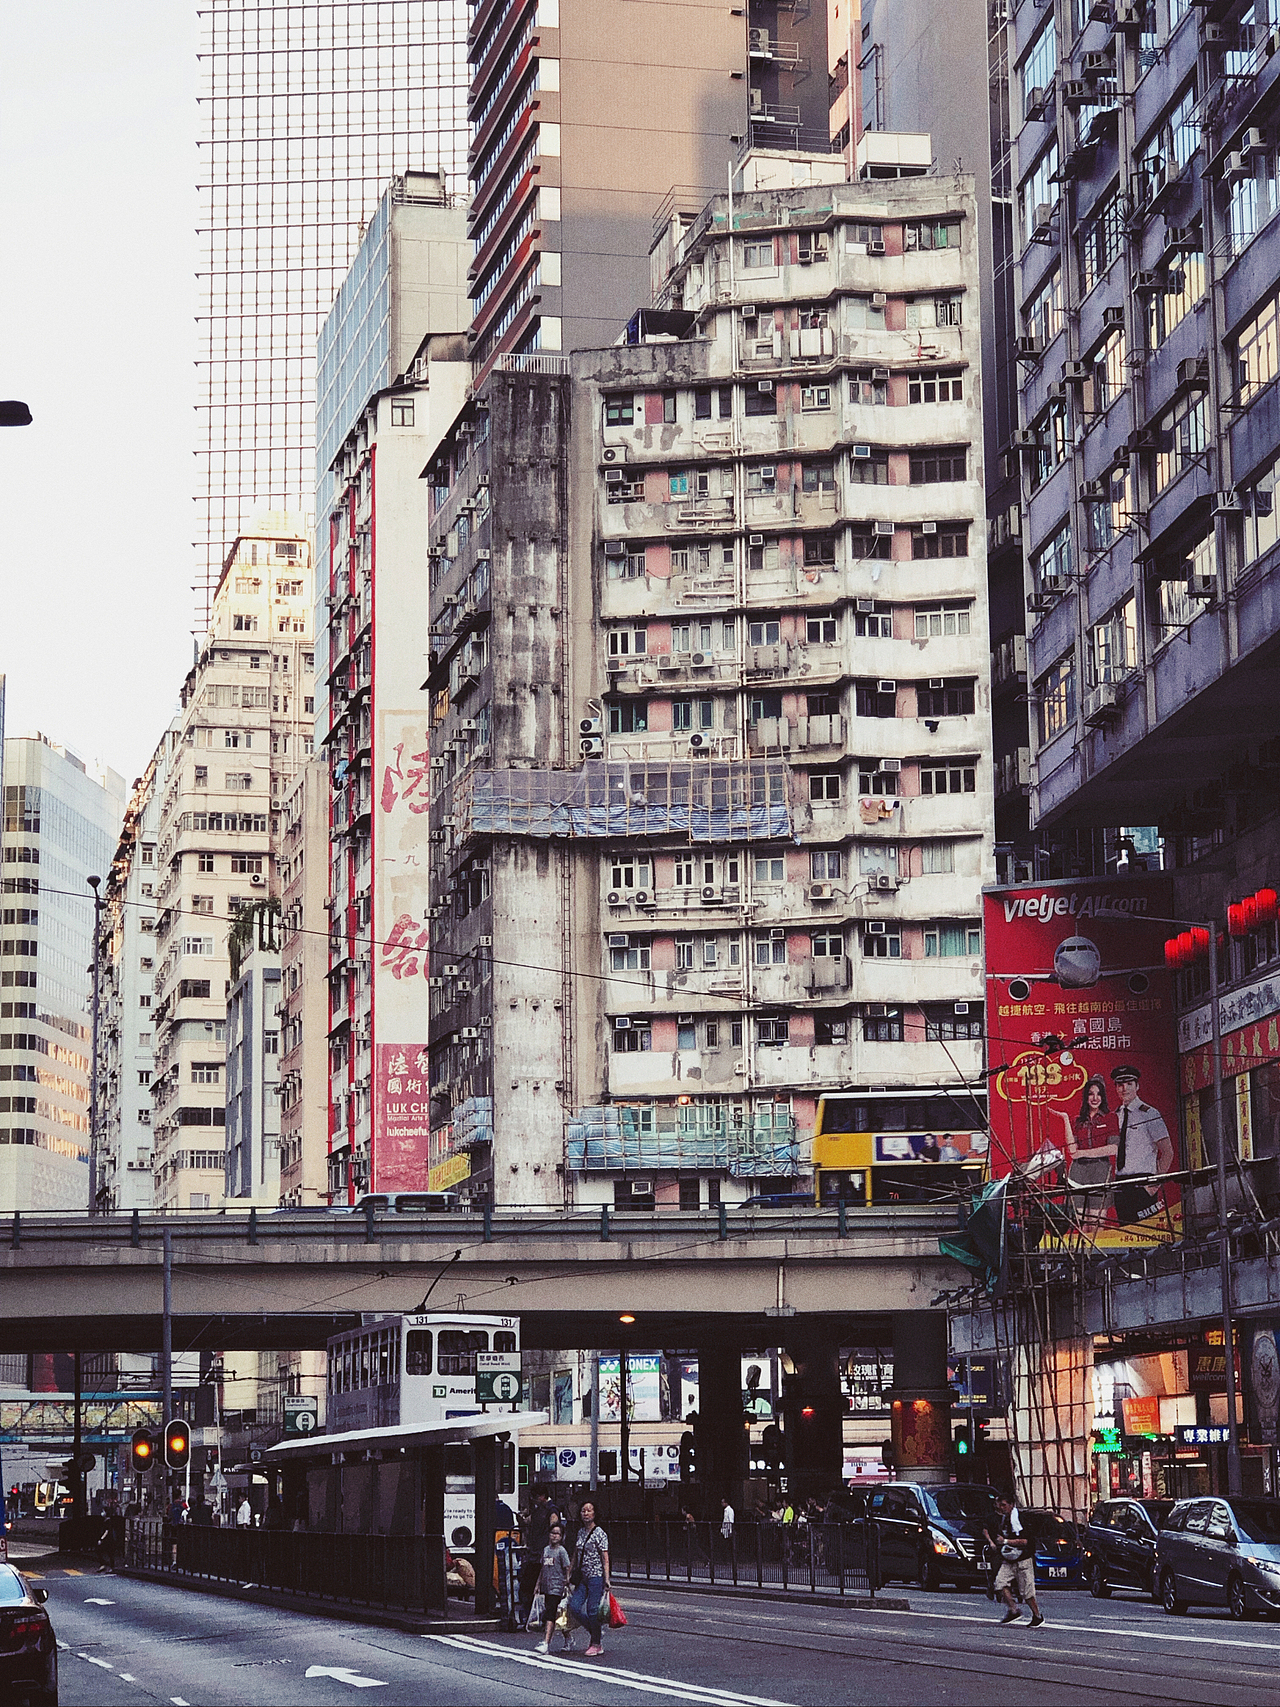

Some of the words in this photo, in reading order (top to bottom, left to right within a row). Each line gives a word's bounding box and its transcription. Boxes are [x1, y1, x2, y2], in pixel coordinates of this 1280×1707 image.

[1072, 1016, 1122, 1034] 富國島
[387, 1078, 428, 1096] 國術
[387, 1103, 407, 1113] LUK
[410, 1103, 428, 1113] CH
[415, 1316, 428, 1324] 131
[500, 1318, 512, 1327] 131
[626, 1358, 657, 1371] ONEX
[1192, 1372, 1226, 1381] wellcom
[433, 1387, 445, 1396] TD
